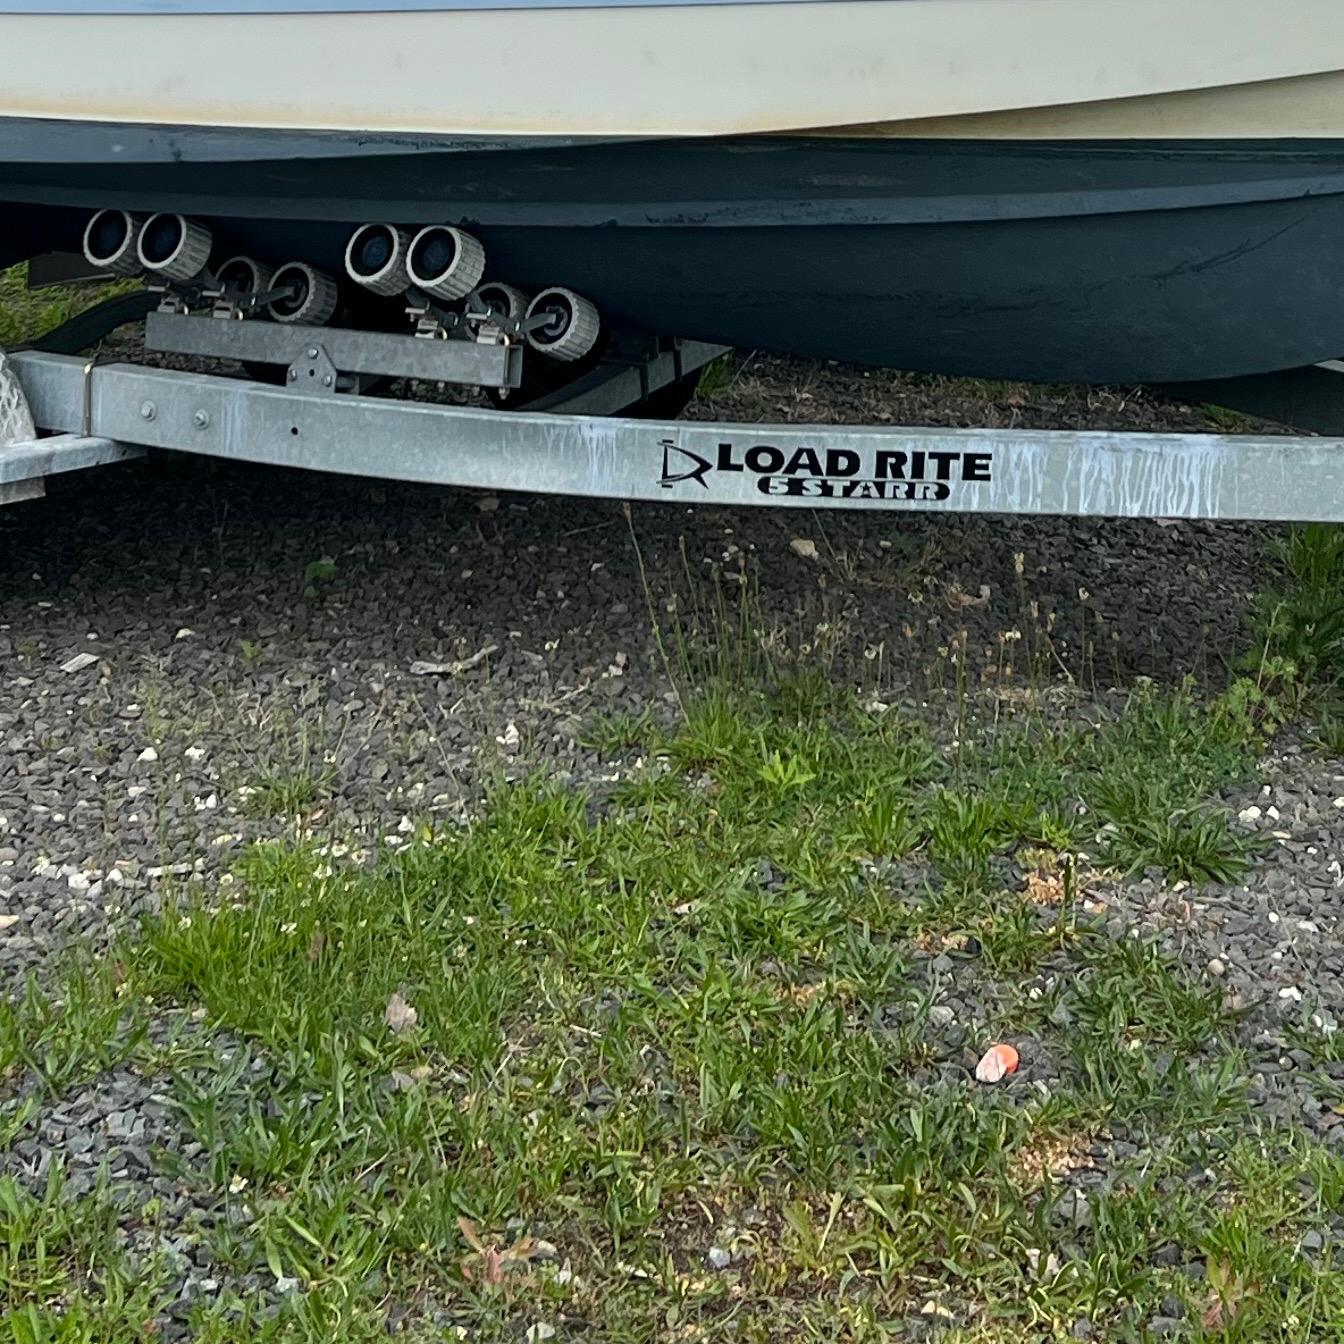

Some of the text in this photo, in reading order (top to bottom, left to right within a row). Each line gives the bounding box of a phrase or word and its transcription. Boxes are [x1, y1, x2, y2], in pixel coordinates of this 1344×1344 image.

[716, 442, 993, 482] LOAD RITE
[768, 476, 790, 495] 5
